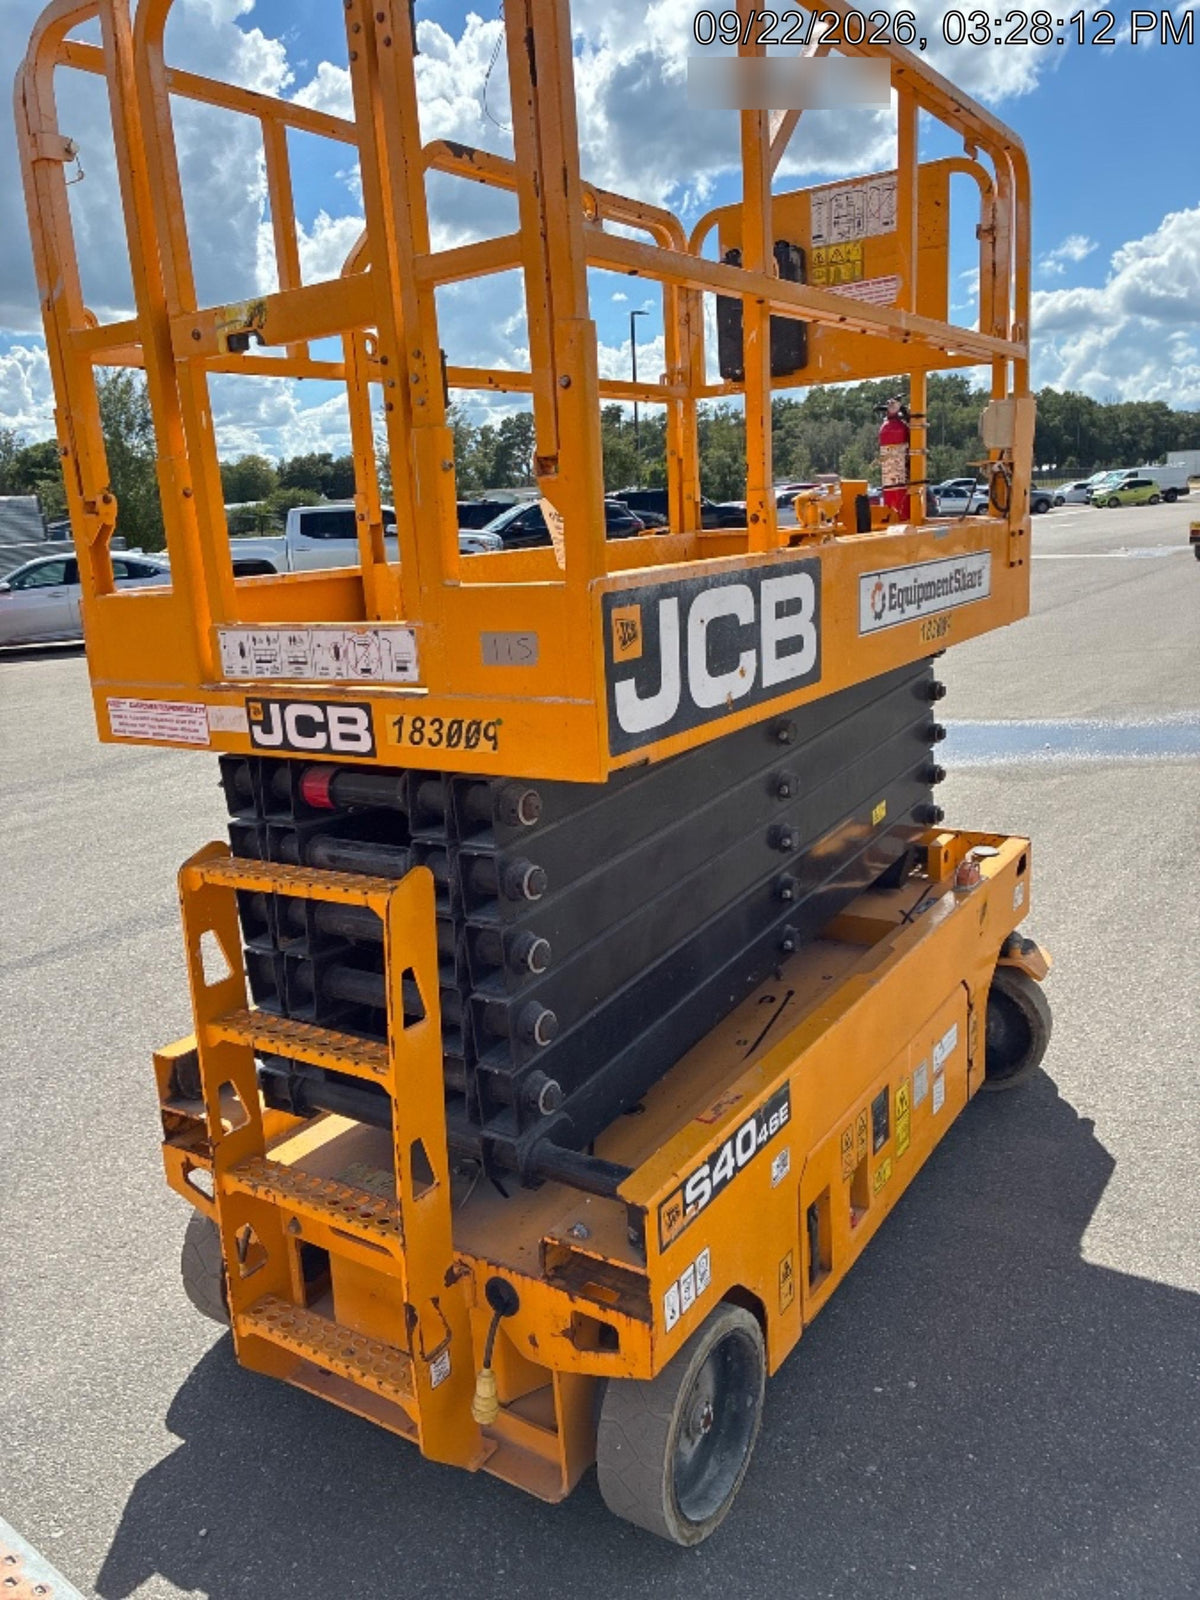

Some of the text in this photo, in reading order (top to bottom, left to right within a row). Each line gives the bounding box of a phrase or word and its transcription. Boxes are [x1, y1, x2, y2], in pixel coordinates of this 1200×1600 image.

[888, 568, 985, 614] EquipmentShare
[616, 572, 818, 734] JCB
[251, 703, 373, 753] JCB
